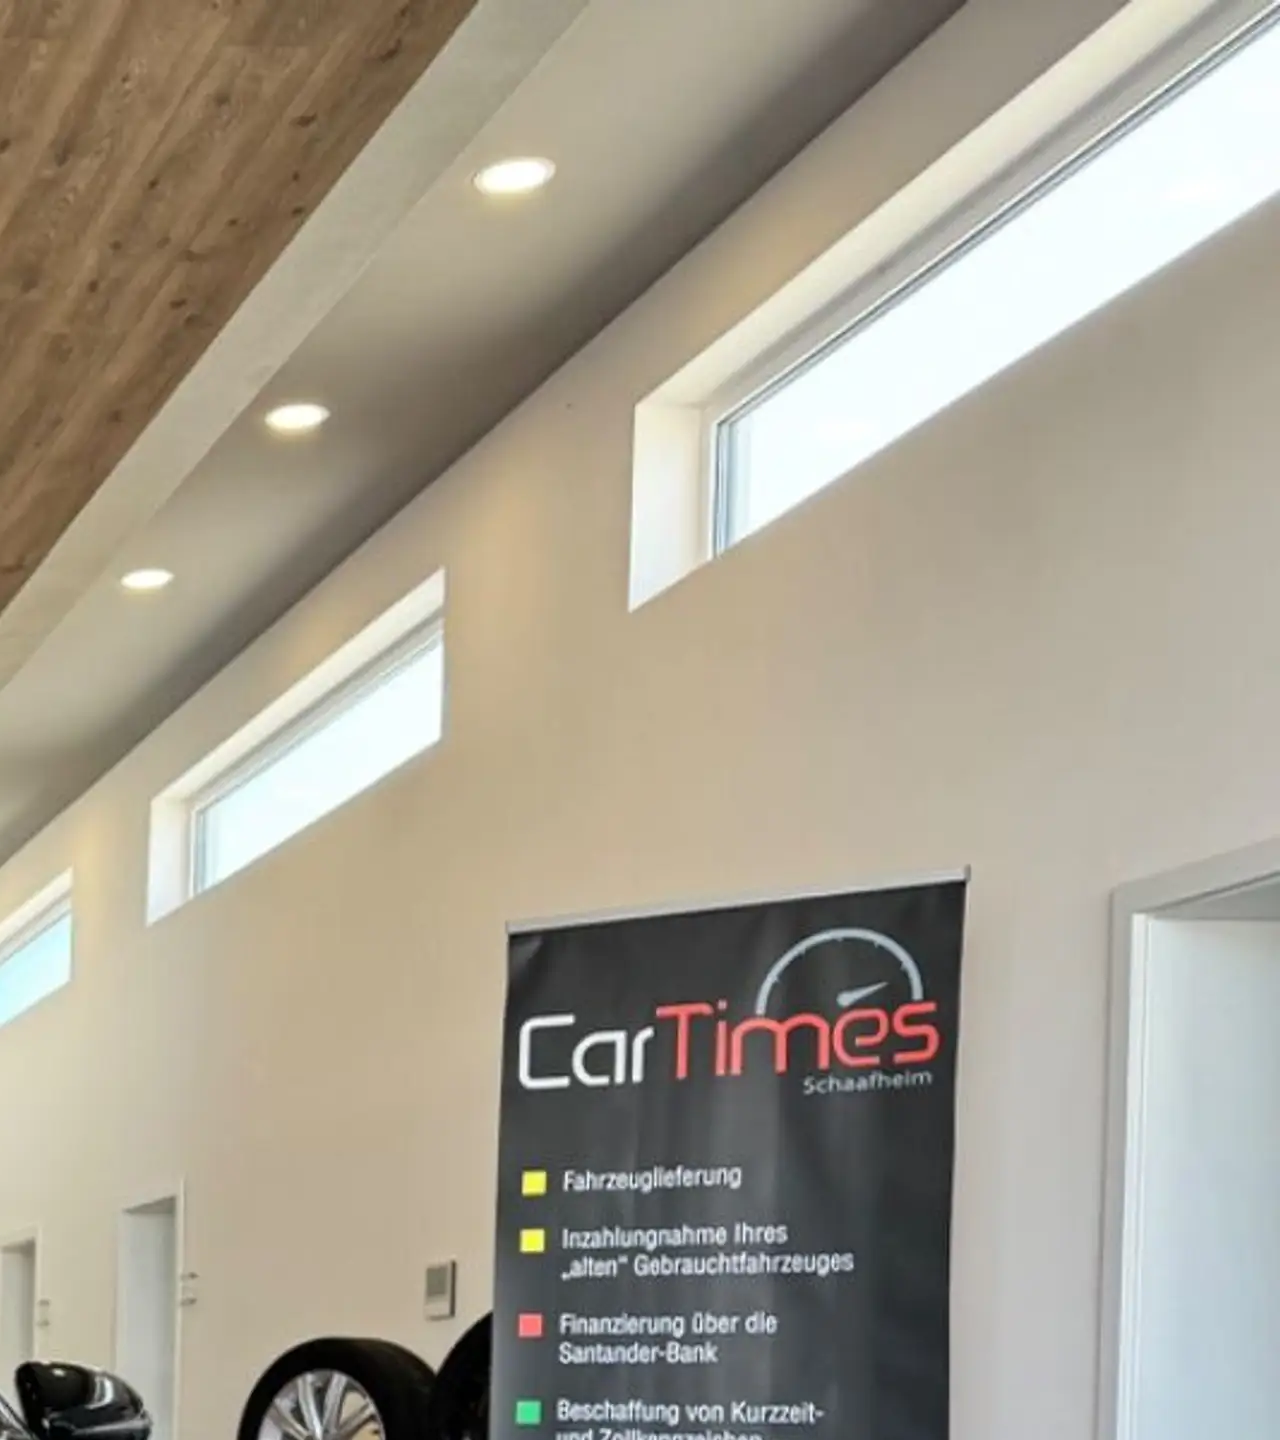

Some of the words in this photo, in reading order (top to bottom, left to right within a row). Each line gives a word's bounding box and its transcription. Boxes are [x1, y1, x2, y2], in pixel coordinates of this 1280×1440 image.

[518, 1001, 940, 1089] CarTimes
[804, 1069, 932, 1095] Schaafheim
[563, 1166, 742, 1193] Fahrzeuglieferung
[562, 1226, 727, 1250] Inzahlungnahme
[734, 1223, 788, 1244] Ihres
[634, 1249, 854, 1276] Gebrauchtfahrzeuges
[560, 1314, 684, 1338] Finanzierung
[692, 1312, 738, 1334] über
[746, 1313, 778, 1334] die
[559, 1342, 718, 1365] Santander-Bank
[556, 1400, 679, 1426] Beschaffung
[686, 1407, 724, 1423] von
[731, 1402, 824, 1426] Kurzzeit-
